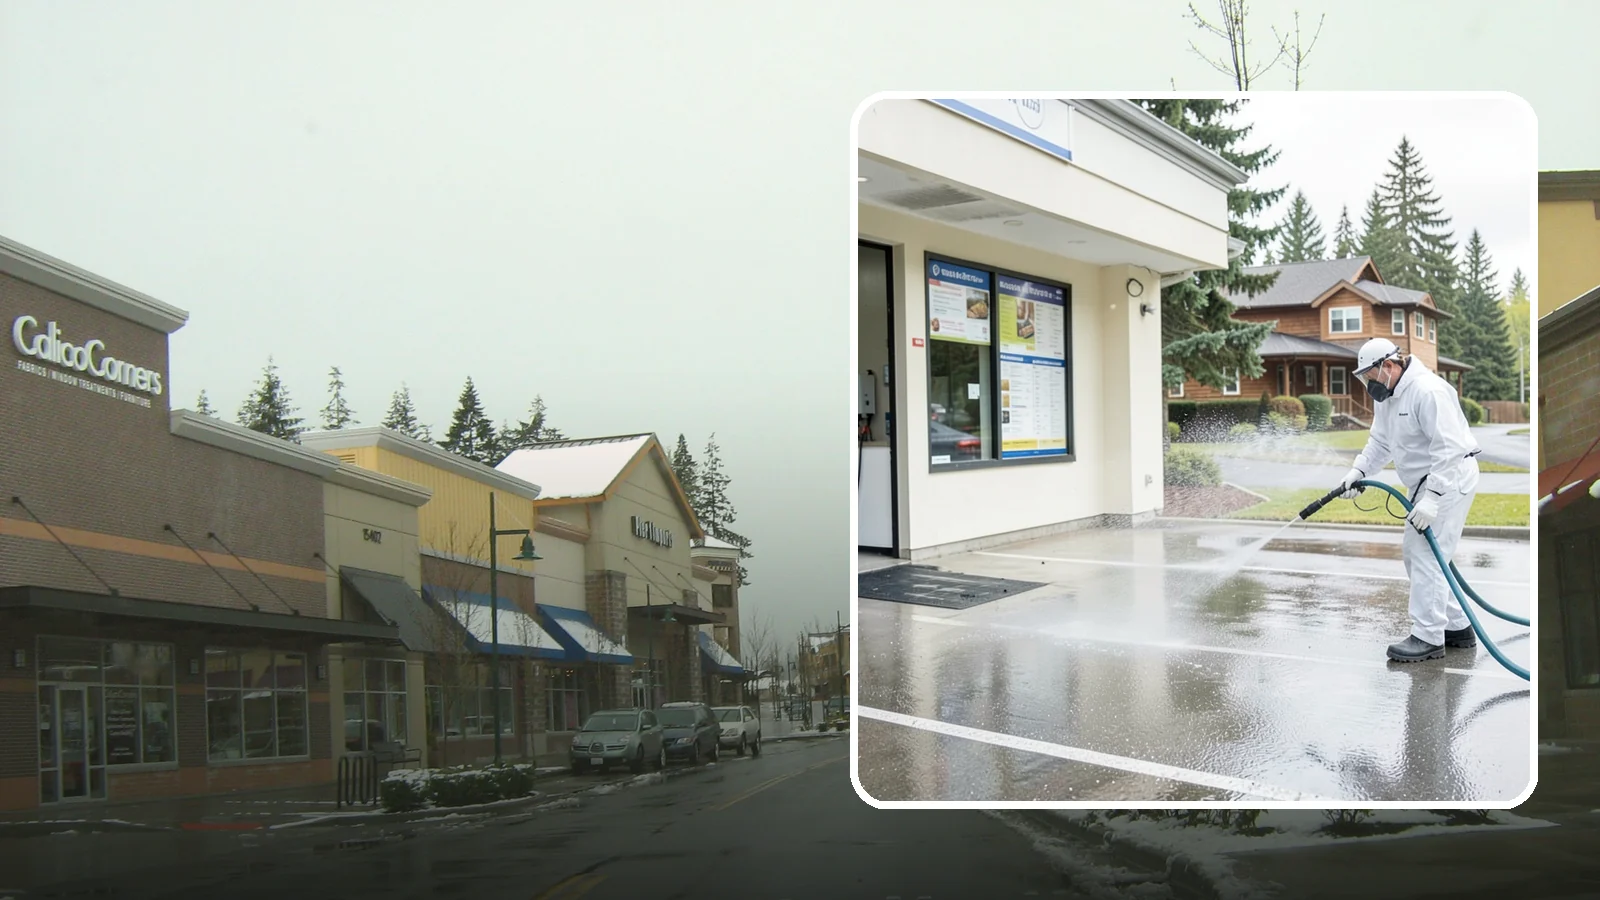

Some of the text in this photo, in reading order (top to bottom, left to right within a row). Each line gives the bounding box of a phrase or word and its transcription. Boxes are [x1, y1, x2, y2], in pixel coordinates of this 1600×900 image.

[17, 360, 47, 378] FABRICS
[52, 370, 78, 386] WINDOW
[79, 378, 116, 398] TREATMENTS
[120, 391, 151, 409] FURNITURE
